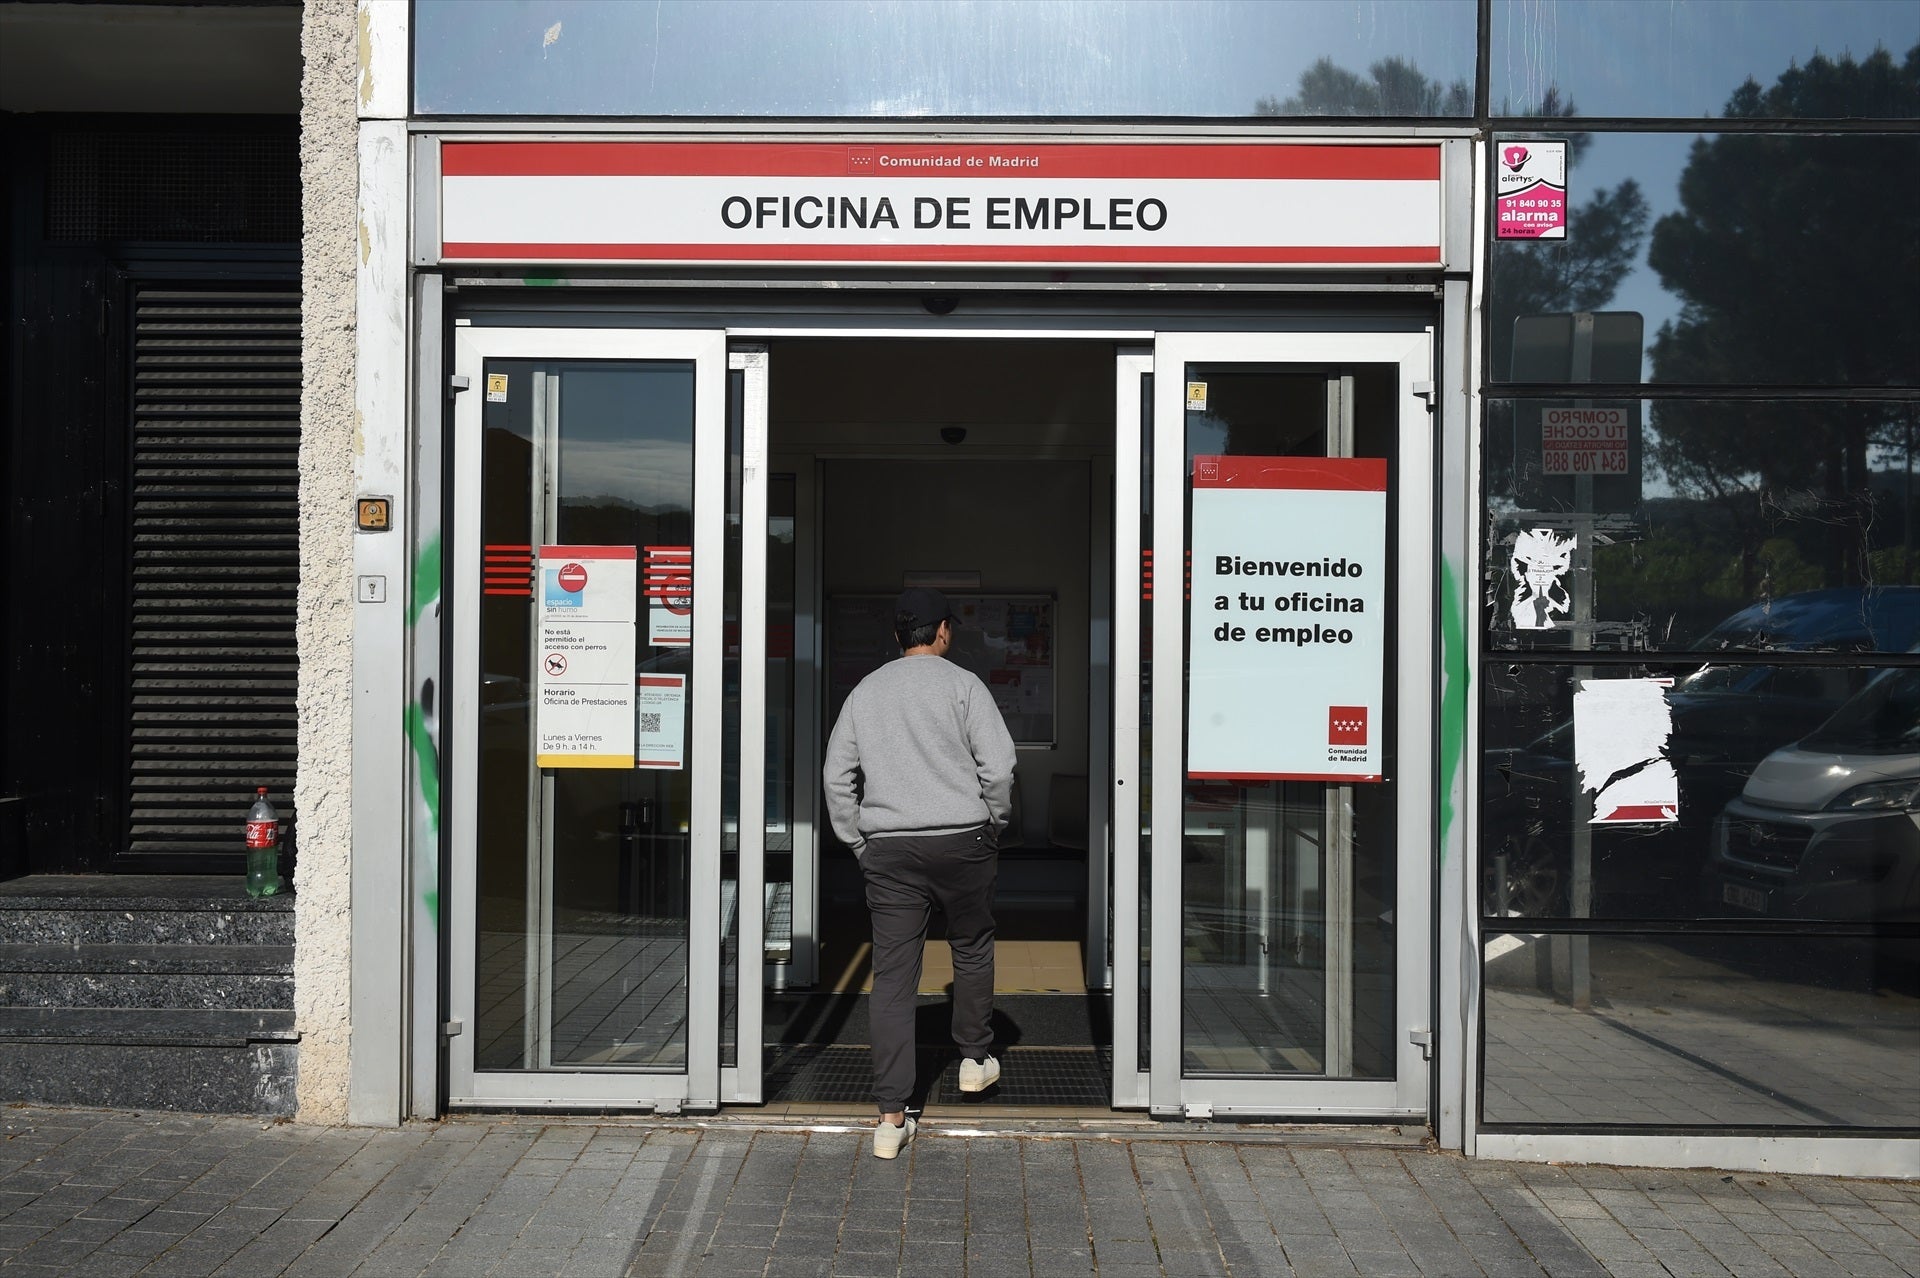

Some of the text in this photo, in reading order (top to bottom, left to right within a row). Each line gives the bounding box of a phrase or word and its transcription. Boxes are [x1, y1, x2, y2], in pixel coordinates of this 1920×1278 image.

[879, 155, 1039, 167] Comunidad de Madrid
[1502, 175, 1532, 183] alertys
[1506, 200, 1562, 208] 91 840 90 35
[721, 195, 1168, 231] OFICINA DE EMPLEO
[1502, 210, 1558, 221] alarma
[1215, 556, 1363, 578] Bienvenido
[546, 599, 573, 607] espacio
[1214, 592, 1364, 613] a tu oficina
[1214, 622, 1353, 647] de empleo
[544, 688, 576, 696] Horario
[543, 697, 569, 705] Oficina
[581, 698, 628, 706] Prestaciones
[543, 733, 566, 741] Lunes
[543, 742, 554, 750] De
[589, 743, 597, 751] h.
